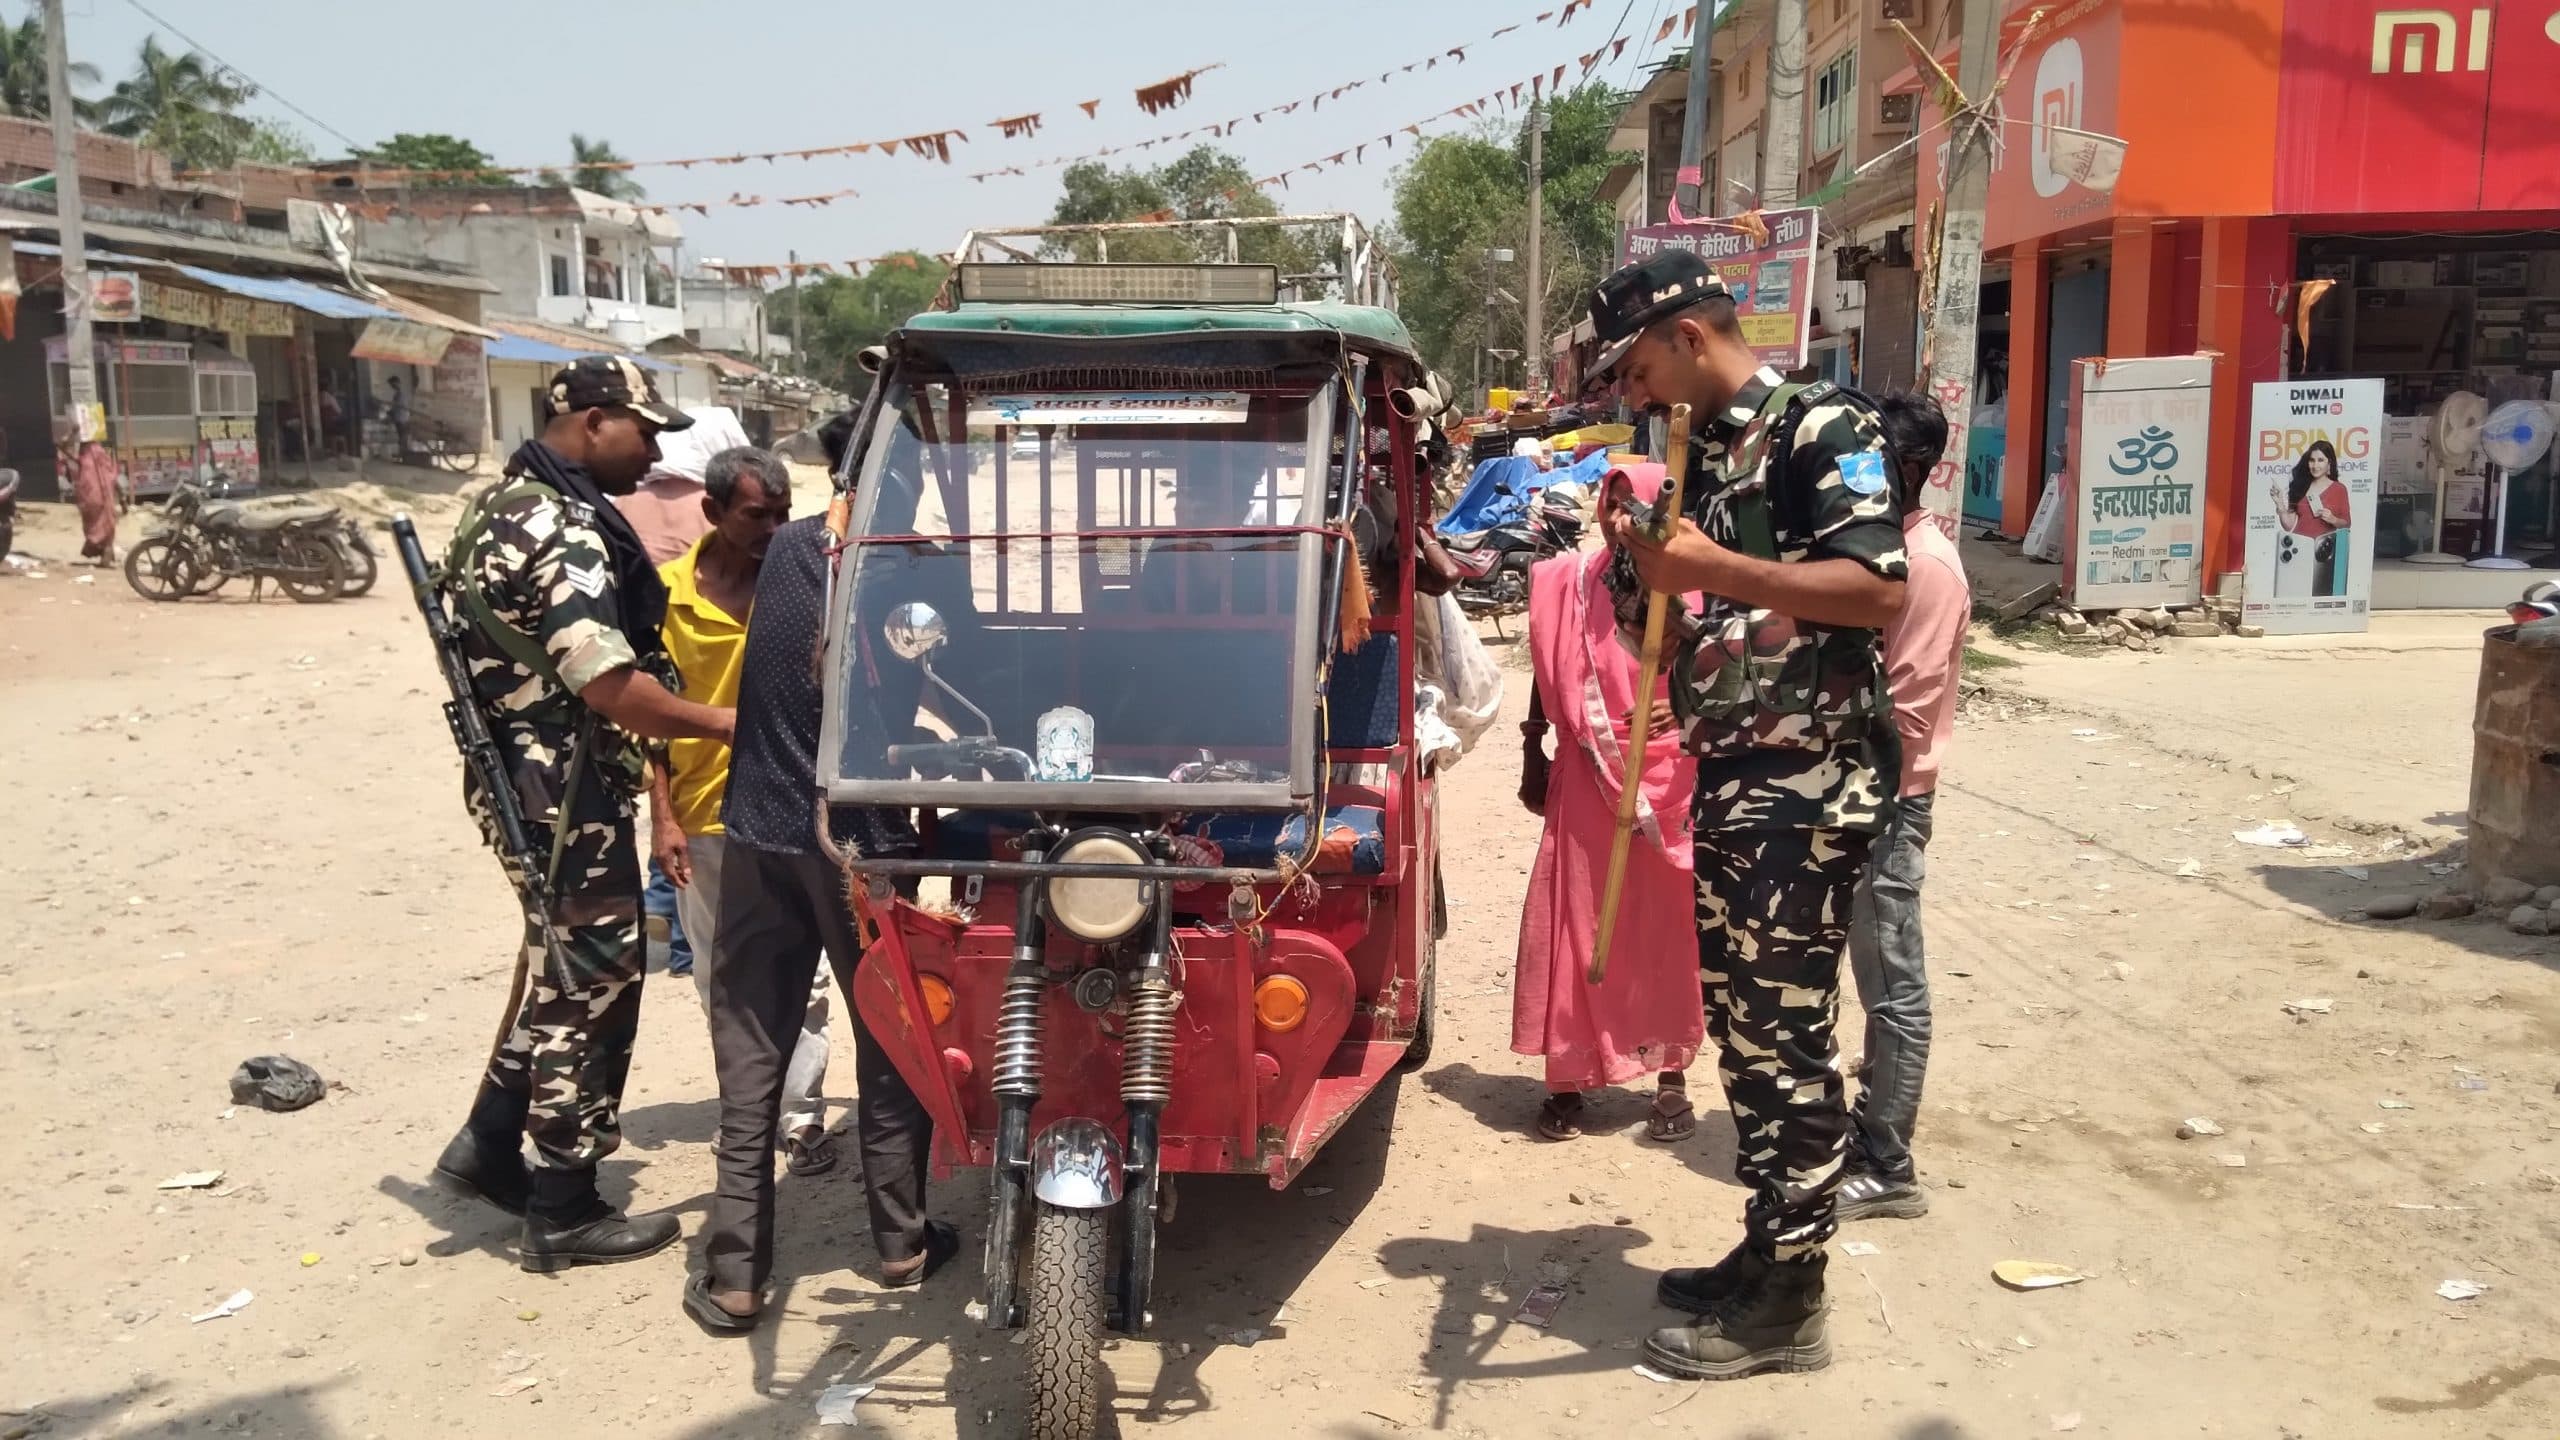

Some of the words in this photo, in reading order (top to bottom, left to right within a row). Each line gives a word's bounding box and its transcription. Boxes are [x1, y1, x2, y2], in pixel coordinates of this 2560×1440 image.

[1629, 234, 1658, 256] अमर
[1700, 232, 1741, 258] कैरियर
[1723, 264, 1751, 277] पटना
[2290, 387, 2344, 401] DIWALI
[2291, 404, 2328, 416] WITH
[2260, 426, 2370, 461] BRING
[2256, 464, 2292, 476] MAGIC
[2112, 545, 2145, 559] Redmi
